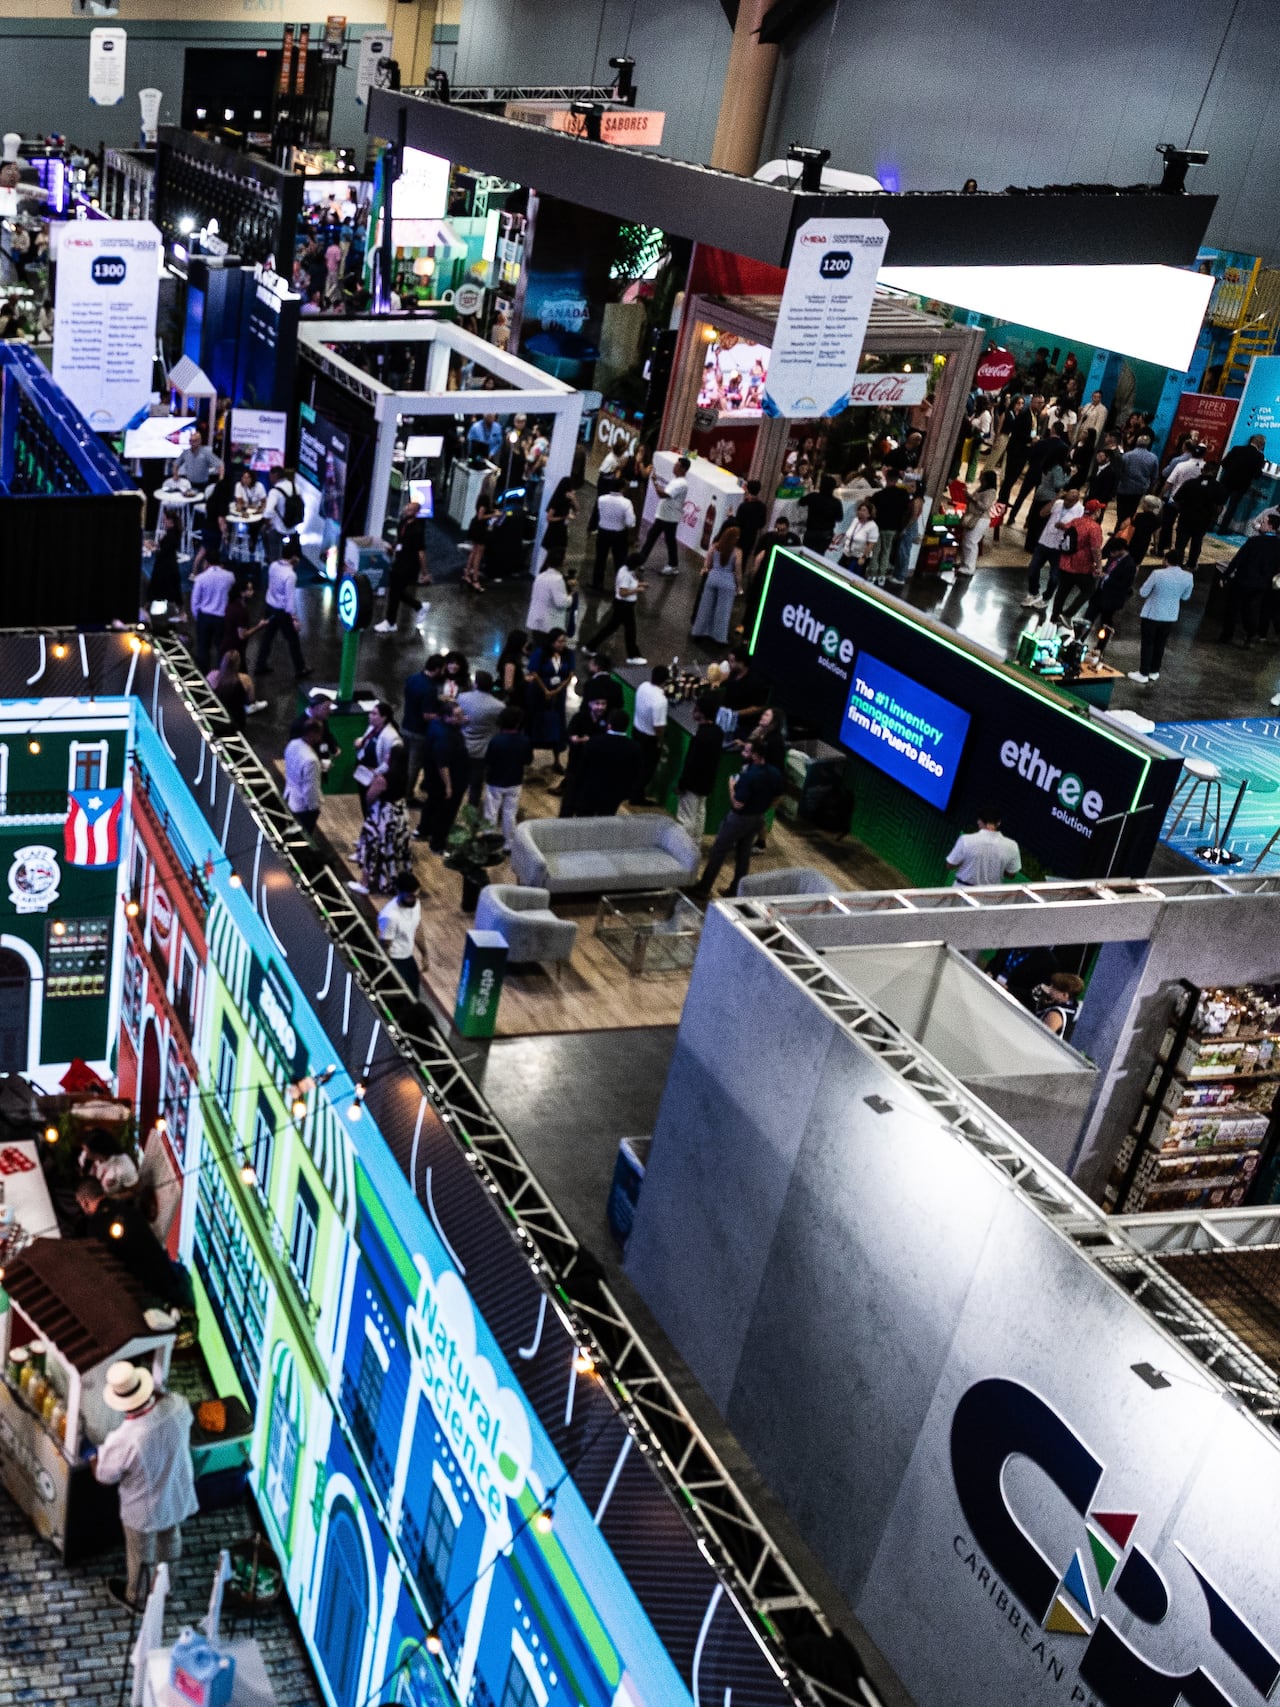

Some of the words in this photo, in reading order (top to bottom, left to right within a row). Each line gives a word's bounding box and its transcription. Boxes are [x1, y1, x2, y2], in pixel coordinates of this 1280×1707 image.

[604, 116, 648, 131] SABORES
[94, 264, 125, 277] 1300
[822, 259, 850, 271] 1200
[1198, 399, 1227, 412] PIPER
[782, 603, 854, 664] ethree
[847, 705, 870, 731] firm
[870, 718, 882, 738] in
[881, 726, 918, 761] Puerto
[917, 750, 944, 778] Rico
[851, 693, 925, 748] management
[855, 677, 875, 700] The
[875, 691, 890, 710] #1
[889, 698, 944, 747] inventory
[1000, 739, 1104, 820] ethree
[421, 1287, 501, 1457] Natural
[422, 1344, 502, 1522] Science
[952, 1535, 1064, 1682] CARIBBEAN
